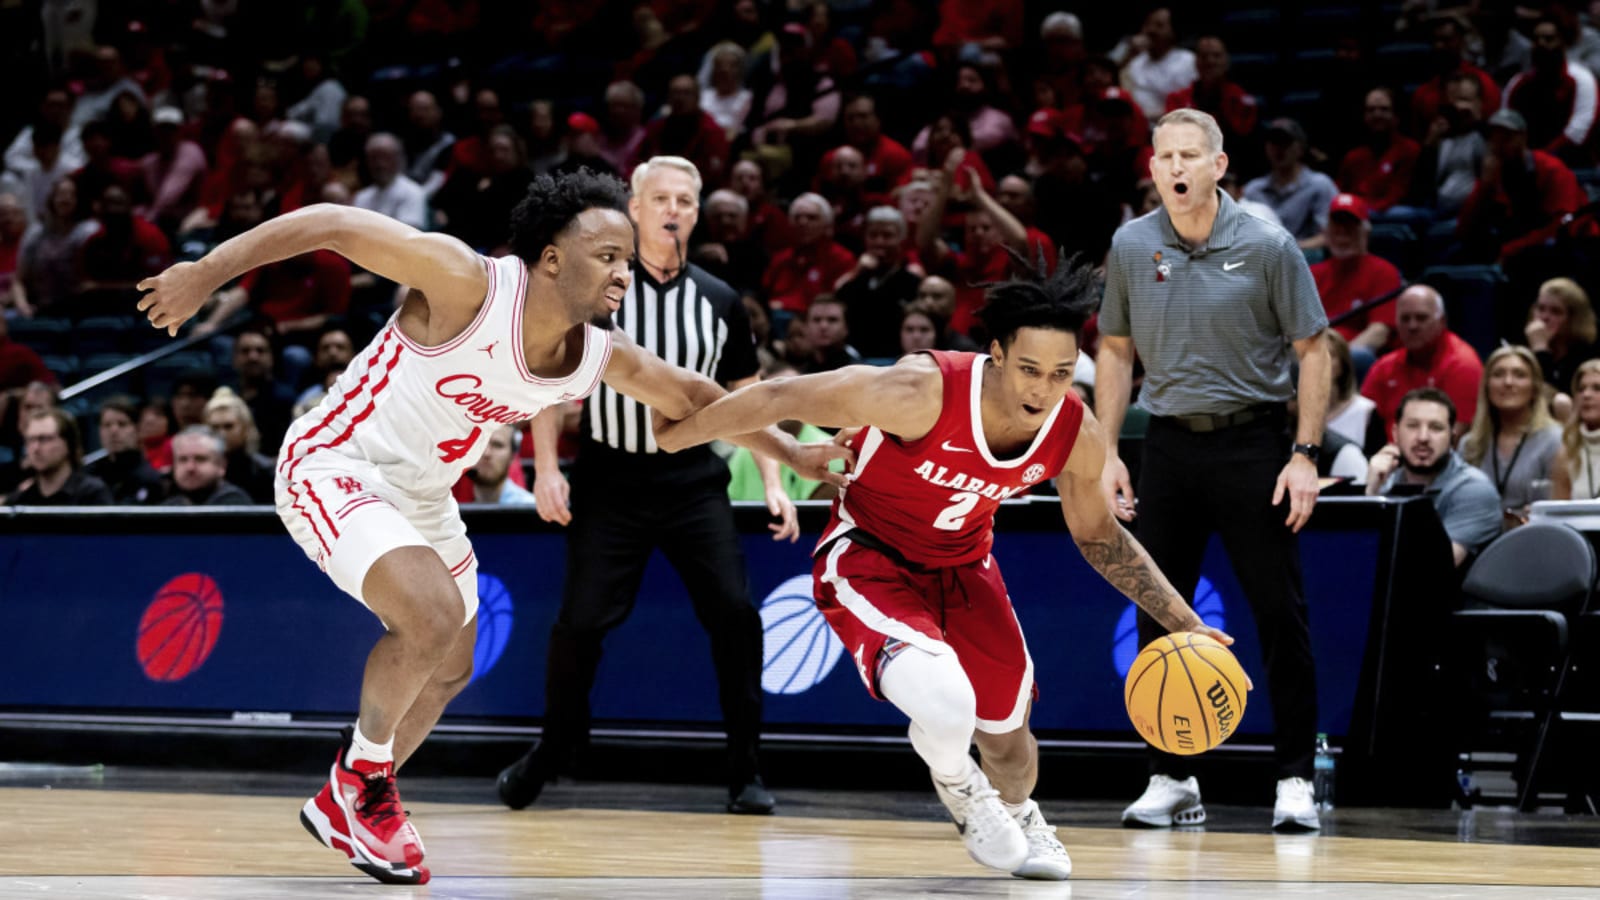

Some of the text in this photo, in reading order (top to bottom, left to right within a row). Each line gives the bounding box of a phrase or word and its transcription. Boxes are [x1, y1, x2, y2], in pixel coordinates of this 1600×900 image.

[437, 425, 482, 463] 4
[914, 460, 1031, 500] ALABAM
[932, 491, 981, 531] 2
[1206, 680, 1234, 739] Wilso
